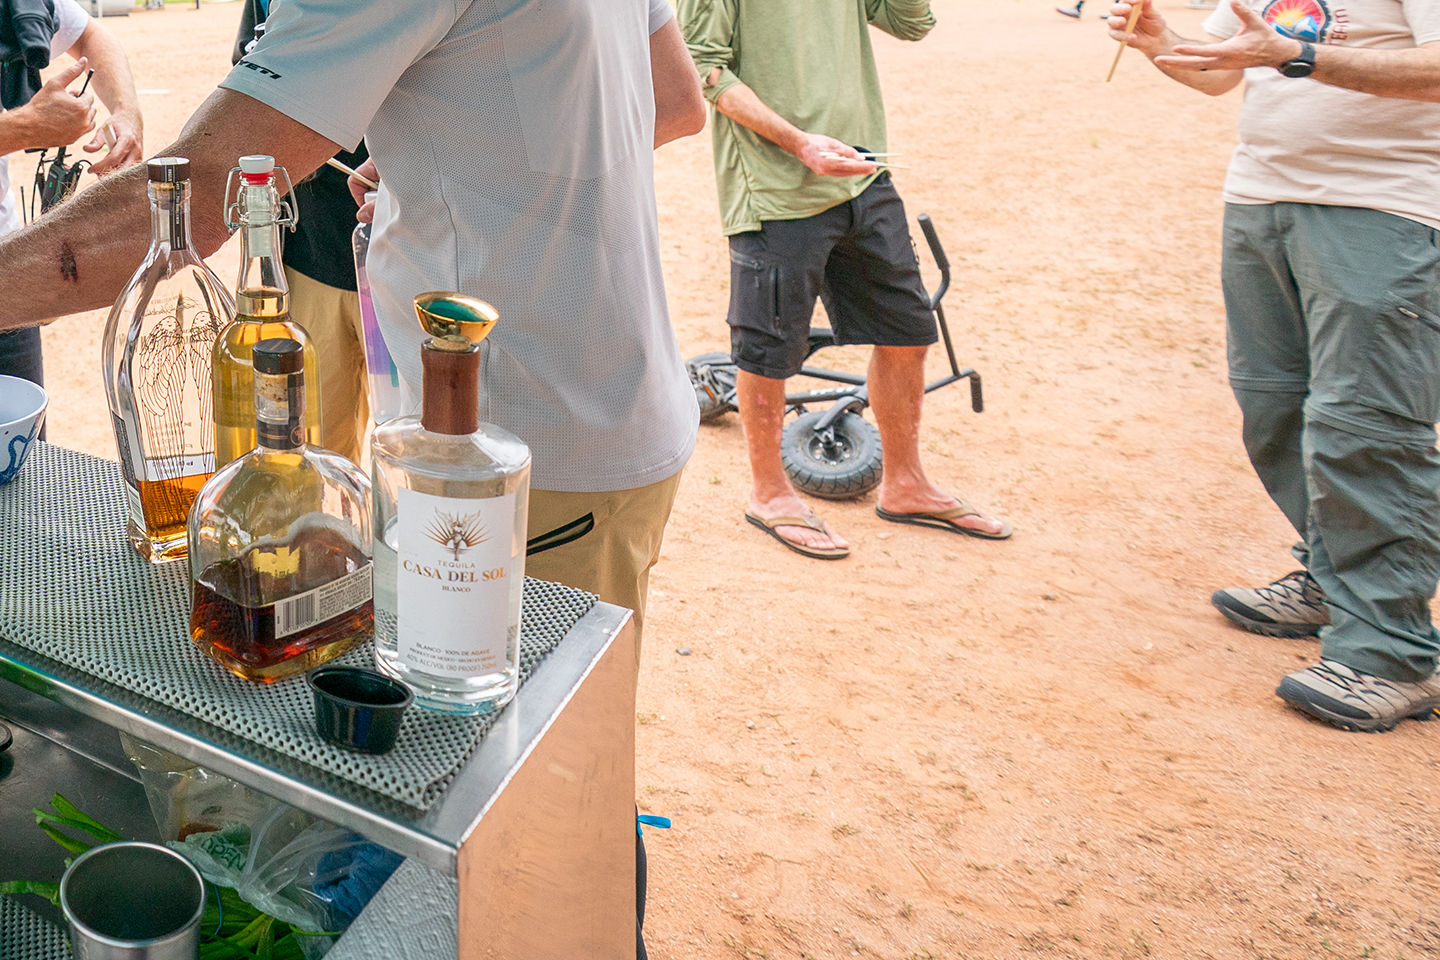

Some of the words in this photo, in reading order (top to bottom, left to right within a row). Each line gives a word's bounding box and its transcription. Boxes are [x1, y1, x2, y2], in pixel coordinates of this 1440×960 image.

[438, 560, 476, 569] TEQUILA
[403, 559, 442, 581] CASA
[447, 570, 479, 583] DEL
[482, 567, 507, 582] SOL
[442, 585, 471, 593] BLANCO
[416, 642, 441, 653] BLANCO
